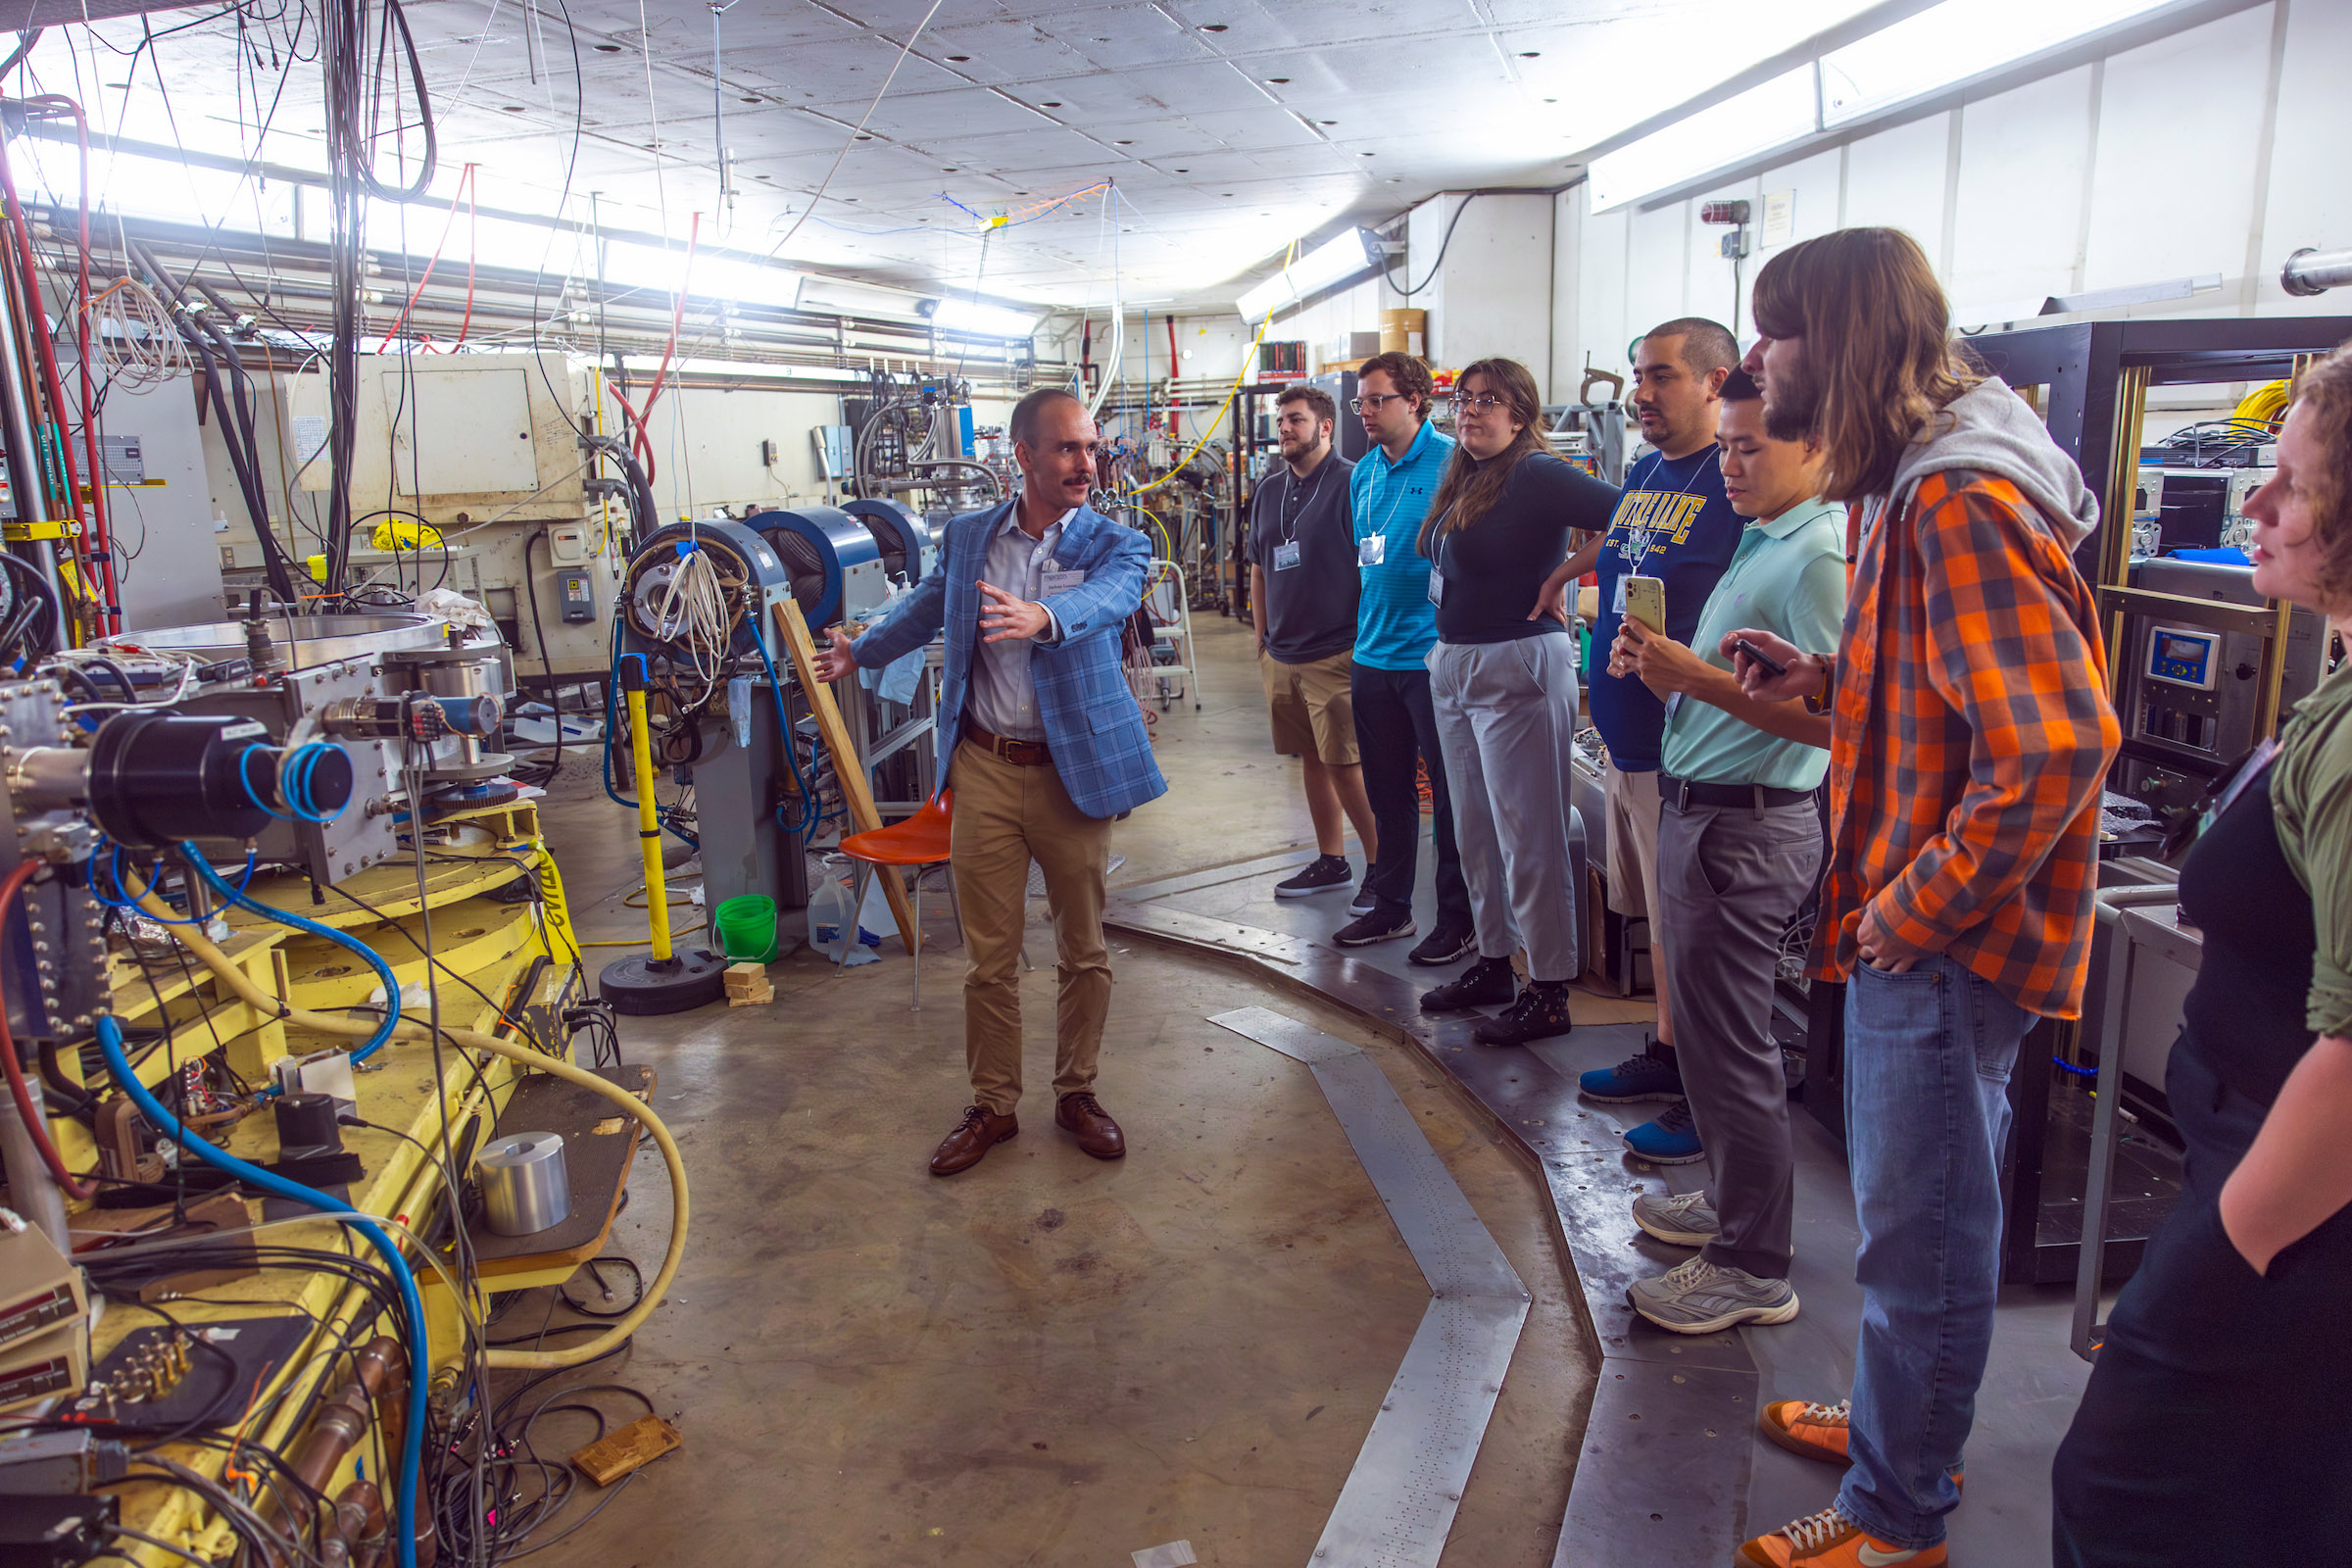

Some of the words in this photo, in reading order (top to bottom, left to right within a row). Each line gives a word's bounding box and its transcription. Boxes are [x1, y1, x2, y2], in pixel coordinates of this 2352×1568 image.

[1607, 492, 1662, 536] NOTRE
[1647, 494, 1707, 545] DAME
[1606, 539, 1620, 548] EST.
